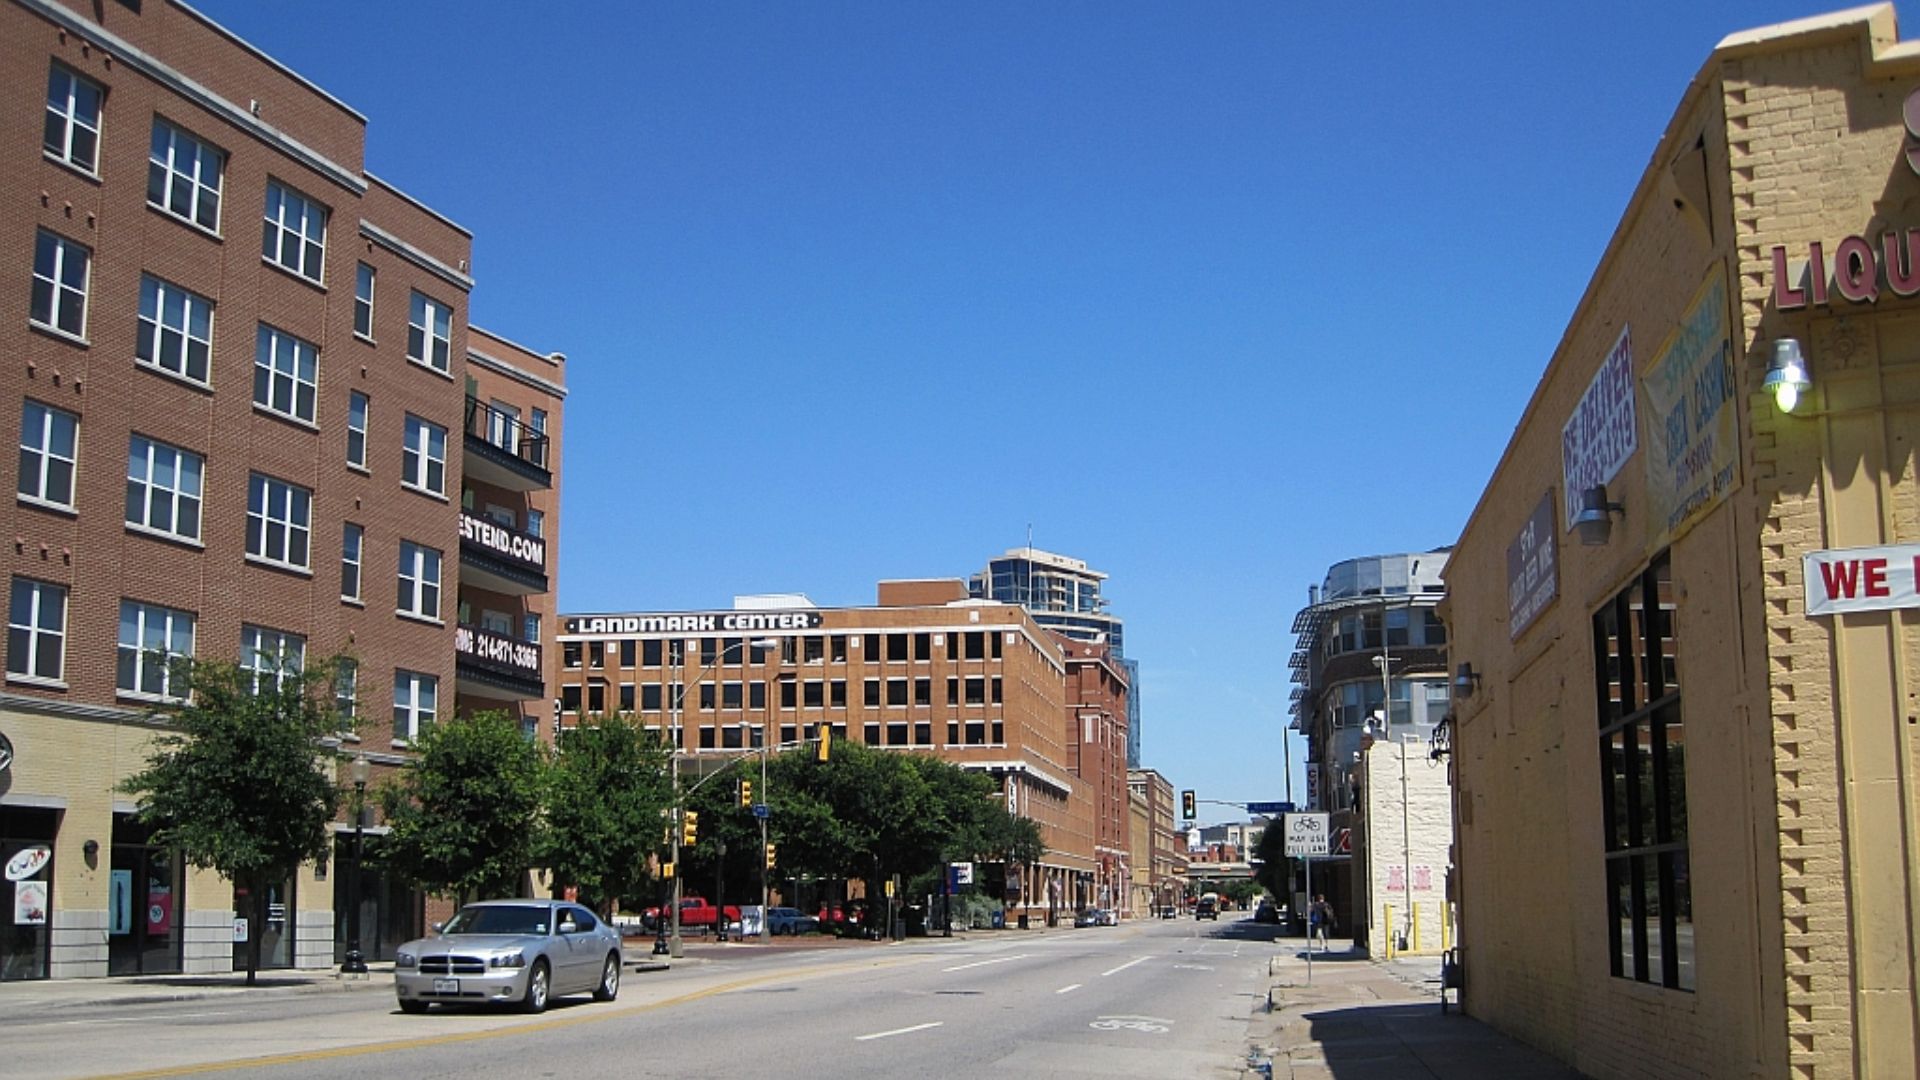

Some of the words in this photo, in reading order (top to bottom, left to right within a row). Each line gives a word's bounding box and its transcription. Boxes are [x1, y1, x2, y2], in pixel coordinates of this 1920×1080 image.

[1772, 227, 1920, 309] LIQU
[1582, 334, 1632, 450] DELIVER
[1820, 558, 1890, 600] WE
[578, 615, 715, 633] LANDMARK
[723, 613, 809, 630] CENTER
